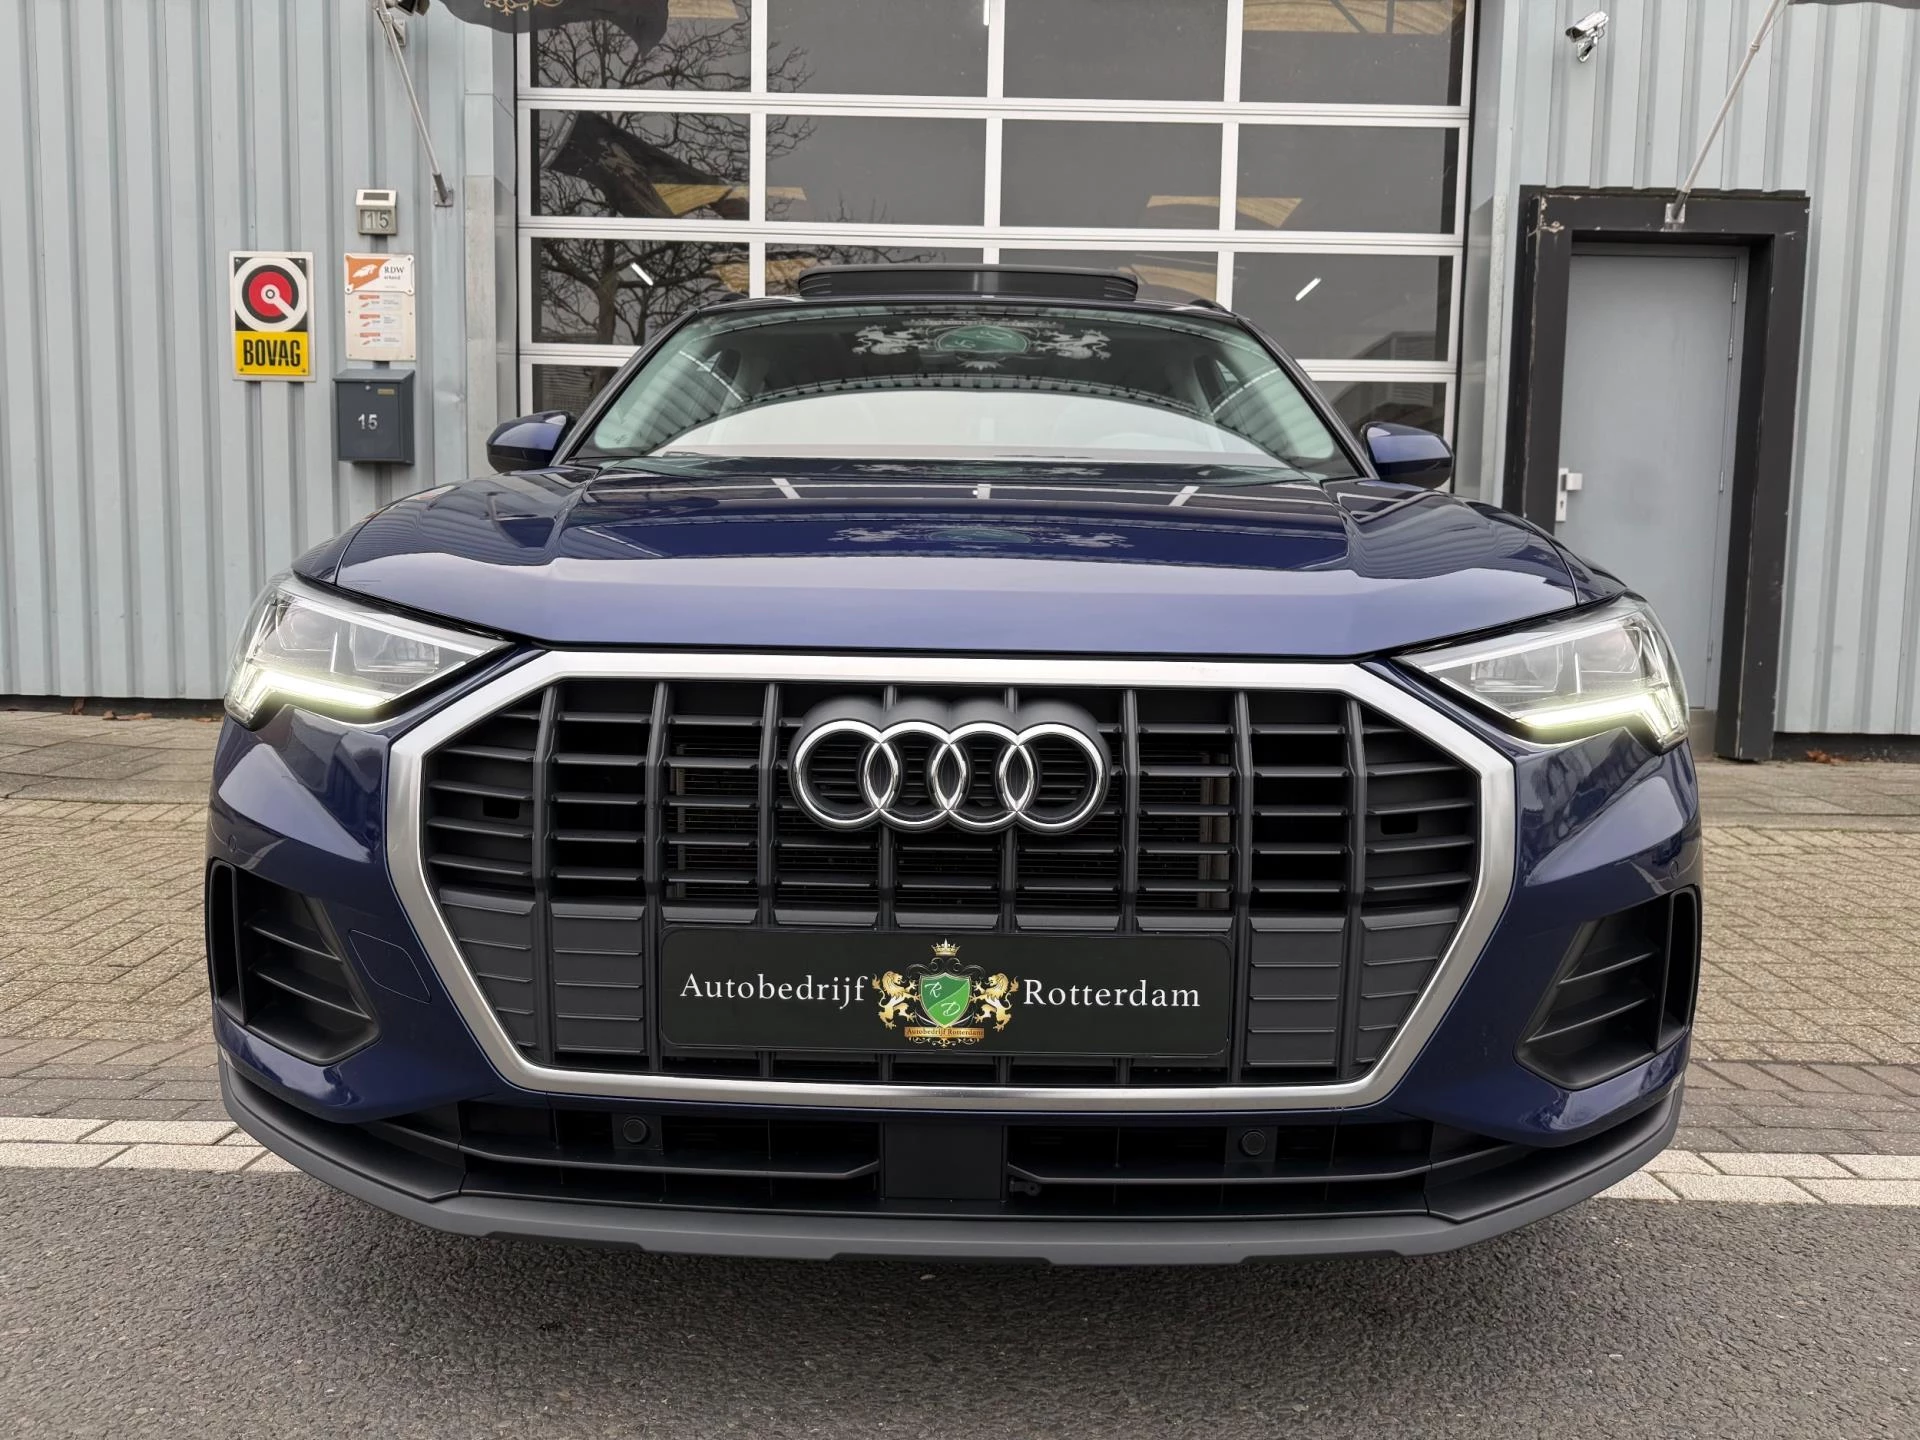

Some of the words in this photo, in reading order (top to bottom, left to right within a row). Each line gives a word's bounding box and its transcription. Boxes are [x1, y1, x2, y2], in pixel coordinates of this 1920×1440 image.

[367, 211, 389, 230] 15
[384, 266, 405, 274] RDW
[243, 338, 301, 367] BOVAG
[357, 413, 378, 429] 15
[680, 973, 868, 1009] Autobedrijf
[1023, 979, 1201, 1009] Rotterdam
[907, 1028, 945, 1037] Autobedrijf
